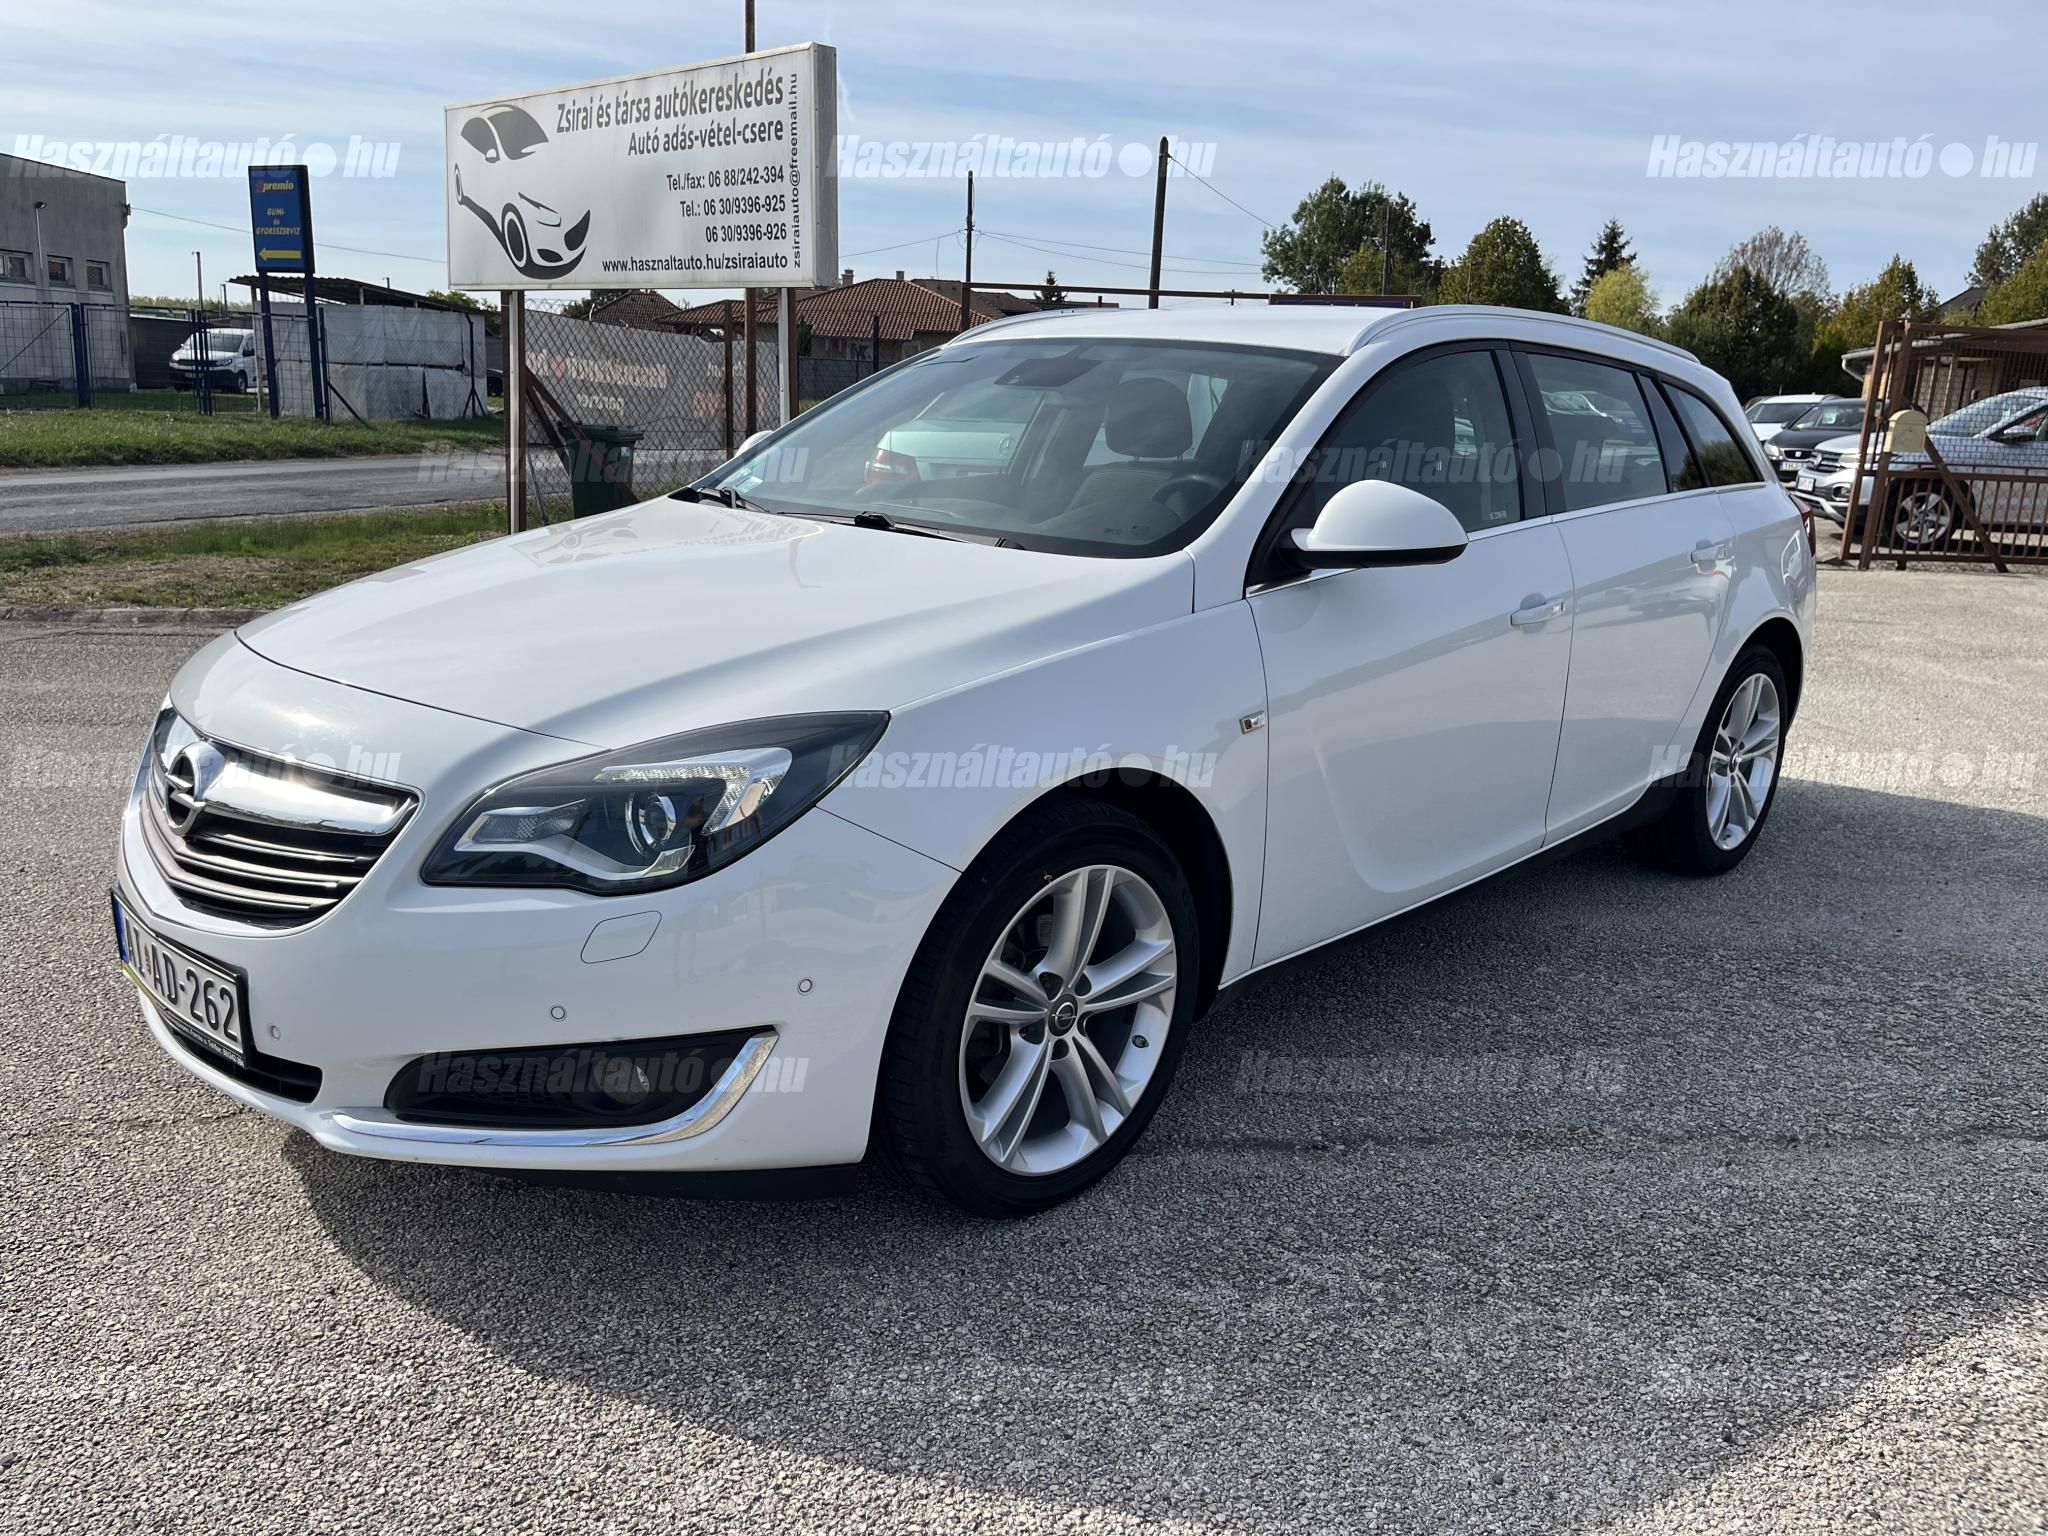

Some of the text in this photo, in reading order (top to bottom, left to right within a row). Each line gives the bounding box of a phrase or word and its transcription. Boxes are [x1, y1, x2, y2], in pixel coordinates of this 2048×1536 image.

[557, 66, 784, 133] Zsirai és társa autókereskedés
[628, 117, 784, 156] Autó adás-vétel-csere
[667, 165, 785, 191] Tel./fax: 06 88/242-394
[789, 73, 801, 269] zsiraiauto@freemail.hu
[262, 181, 294, 192] premio
[680, 194, 786, 217] Tel.: 06 30/9396-925
[705, 222, 787, 243] 06 30/9396-926
[602, 252, 788, 272] www.hasznaltauto.hu/zsiraiauto
[151, 943, 239, 1042] AD-262
